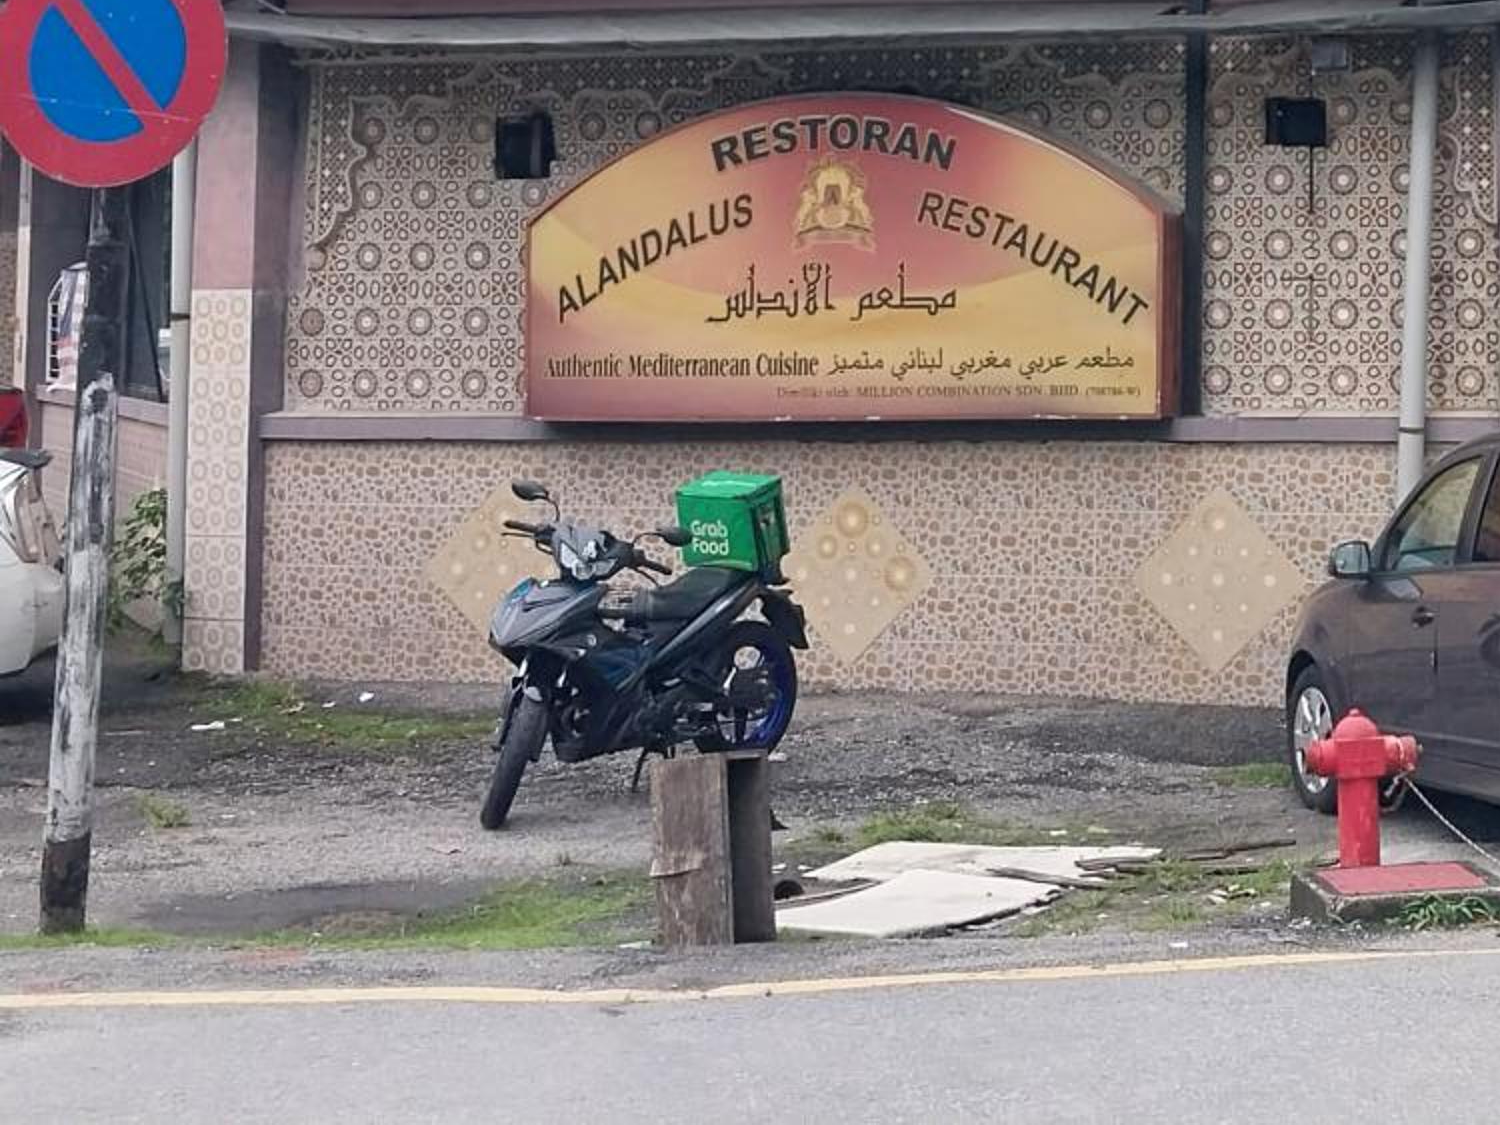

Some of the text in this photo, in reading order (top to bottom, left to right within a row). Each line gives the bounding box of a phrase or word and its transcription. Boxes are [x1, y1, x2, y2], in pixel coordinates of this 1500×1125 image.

[710, 117, 956, 172] RESTORAN
[558, 194, 753, 324] ALANDALUS
[917, 192, 1149, 324] RESTAURANT
[850, 263, 957, 321] مطعم
[547, 351, 819, 377] Authentic Mediterranean Cuisine
[827, 346, 1134, 380] مطعم عربي مغربي لبناني متميز
[857, 386, 912, 398] MILLION
[917, 386, 1011, 397] COMBINATION
[690, 519, 728, 538] Grab
[692, 537, 729, 555] Food
